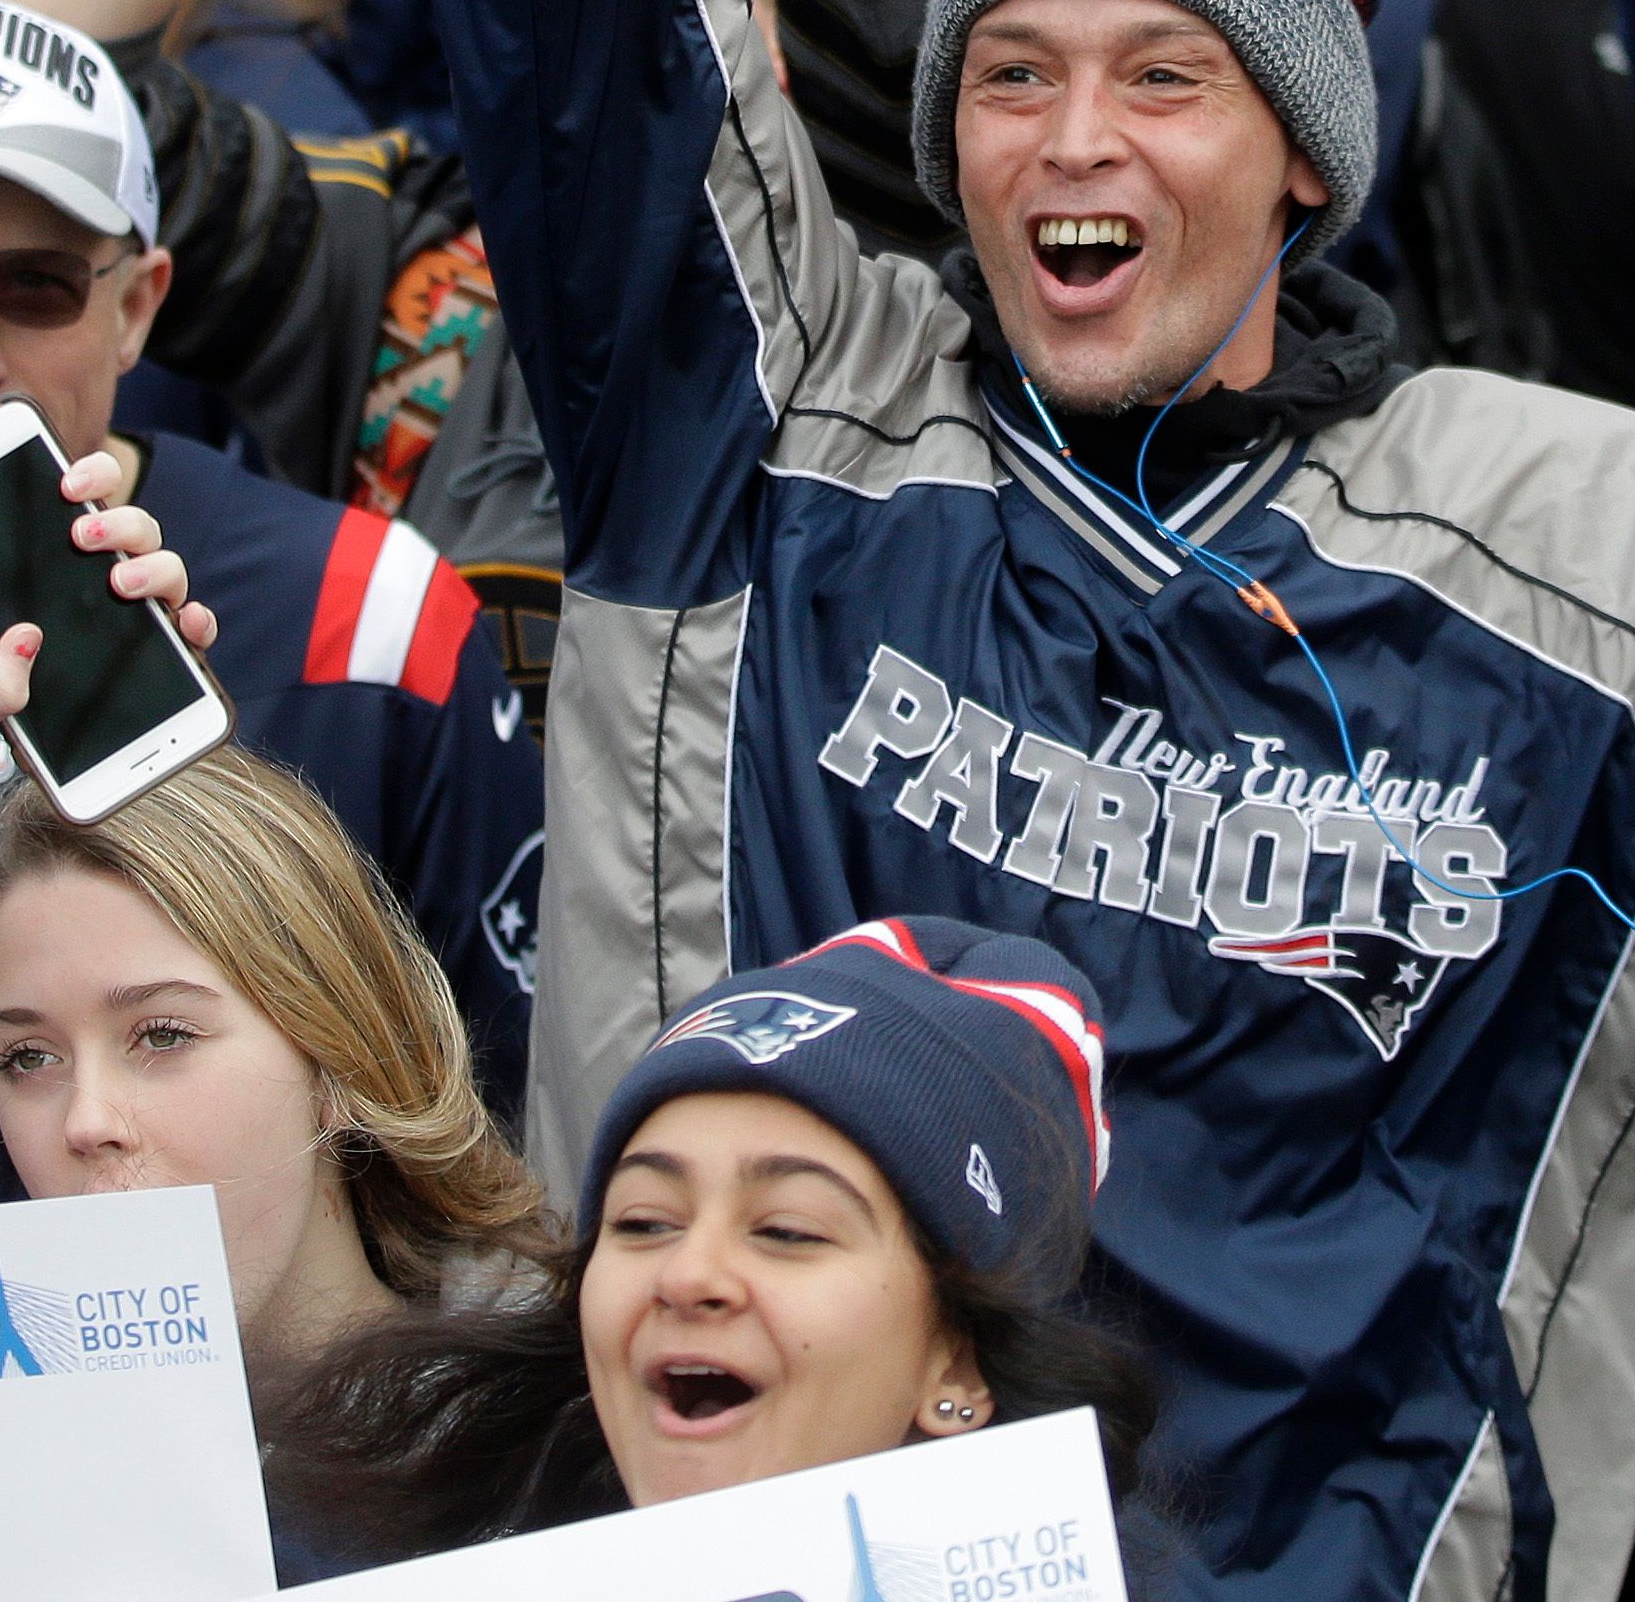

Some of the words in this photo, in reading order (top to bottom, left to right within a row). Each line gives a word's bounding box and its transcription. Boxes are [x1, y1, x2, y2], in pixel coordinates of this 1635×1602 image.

[1082, 695, 1235, 792] New
[1235, 732, 1491, 826] England
[818, 644, 1509, 959] PATRIOTS
[76, 1288, 147, 1323] CITY
[159, 1284, 200, 1315] OF
[80, 1316, 209, 1352] BOSTON
[84, 1353, 148, 1373] CREDIT
[945, 1532, 1020, 1576] CITY
[1035, 1519, 1078, 1557] OF
[950, 1554, 1088, 1602] BOSTON
